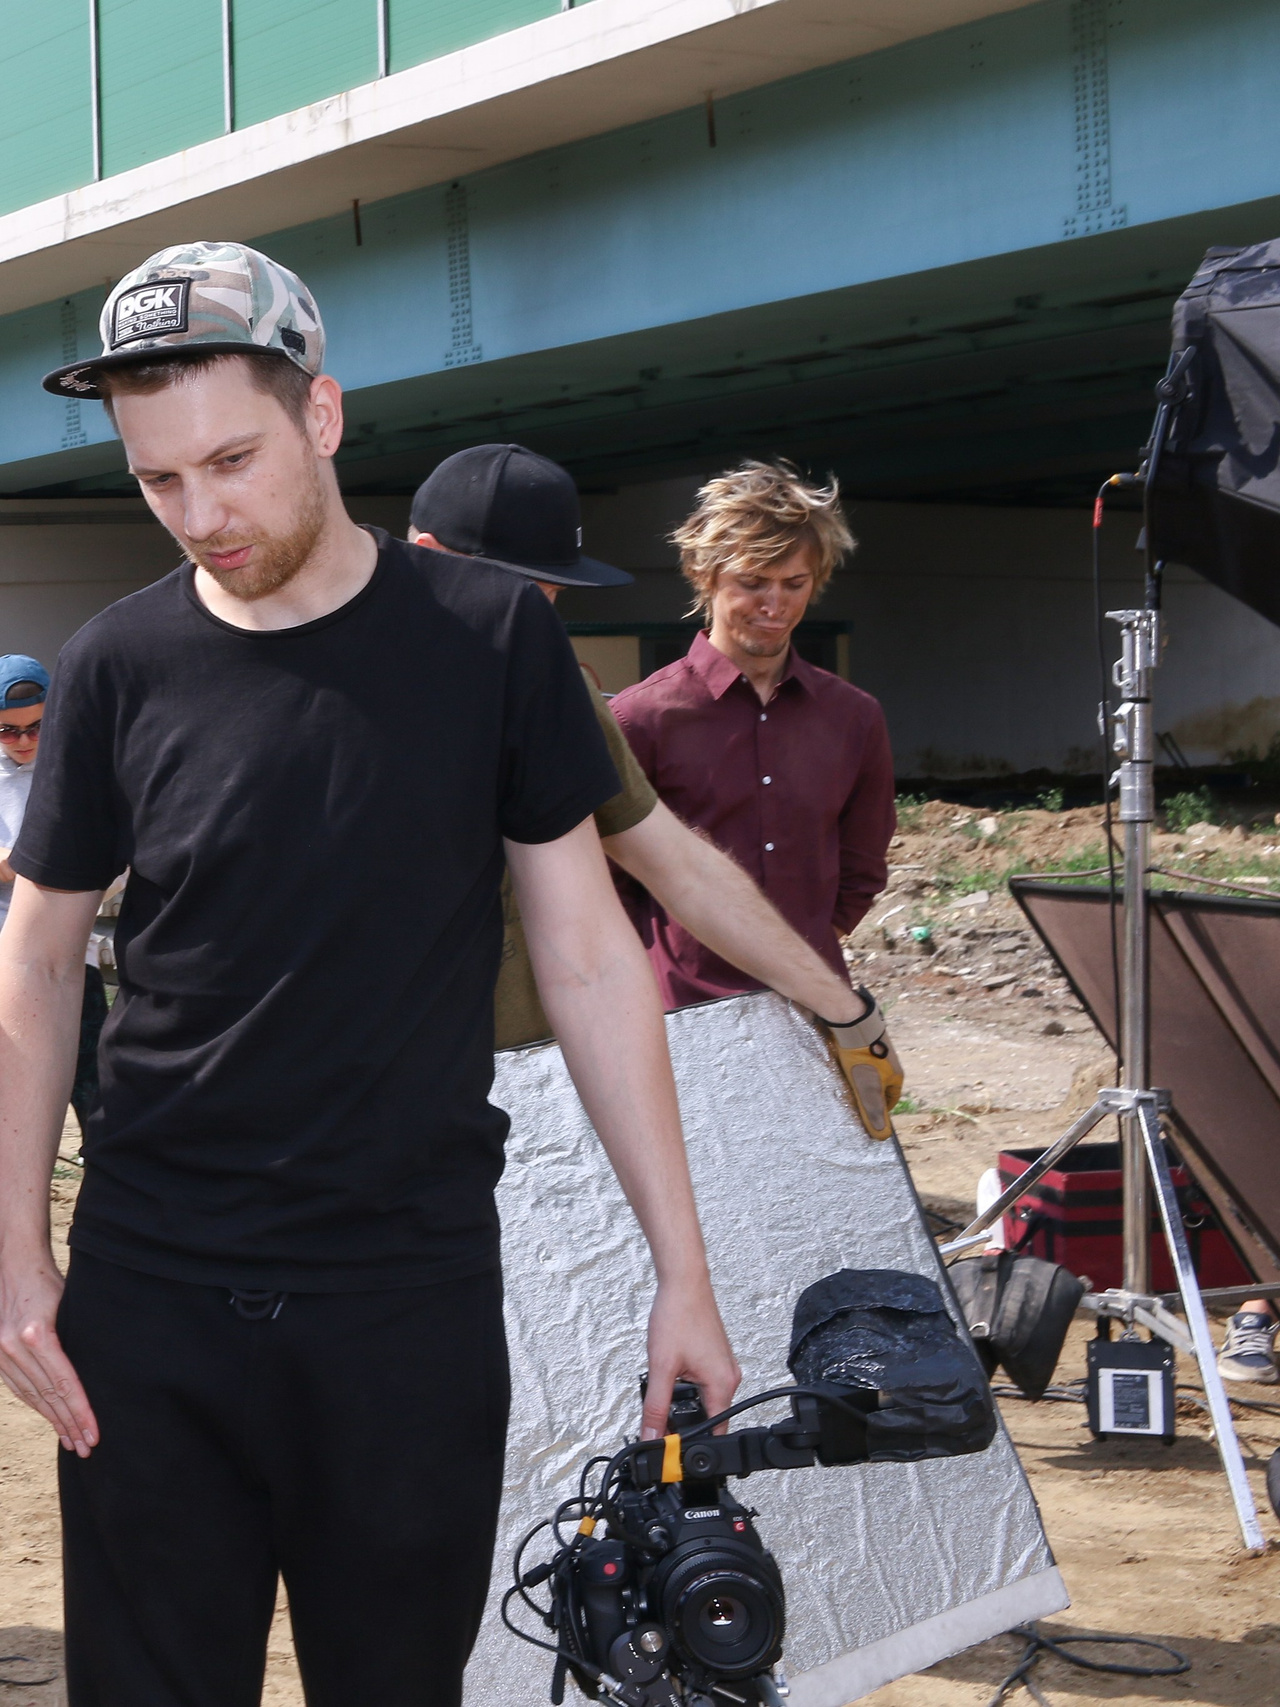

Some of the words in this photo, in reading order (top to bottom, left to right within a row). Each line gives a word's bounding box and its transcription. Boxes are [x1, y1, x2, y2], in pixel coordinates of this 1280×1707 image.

[119, 287, 177, 321] DGK
[135, 317, 178, 332] Nothing
[684, 1509, 721, 1520] Canon
